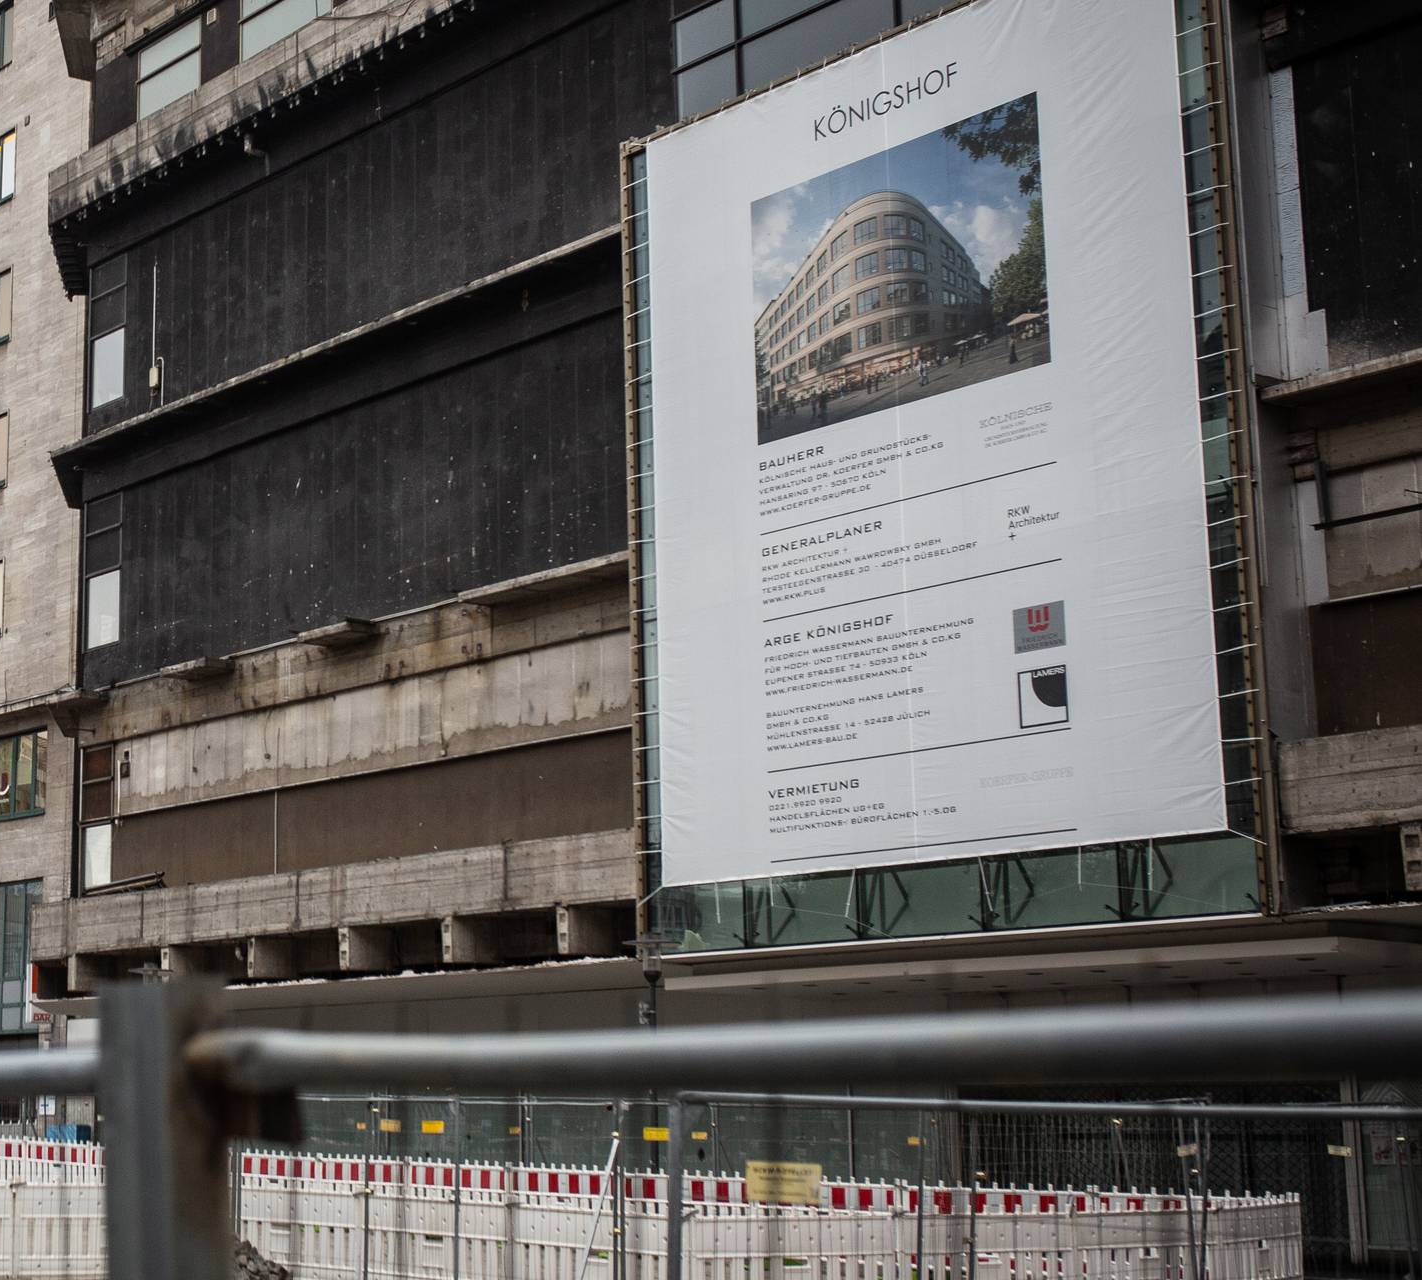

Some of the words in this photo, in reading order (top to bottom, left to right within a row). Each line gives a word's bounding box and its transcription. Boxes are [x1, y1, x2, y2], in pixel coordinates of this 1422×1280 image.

[814, 62, 957, 141] KÖNIGSHOF
[759, 446, 824, 471] BAUHERR
[759, 467, 806, 484] KÖLNISCHE
[839, 454, 858, 463] UND
[860, 434, 932, 457] GRUNDSTÜCKS-
[759, 476, 813, 495] VERWALTUNG
[833, 461, 873, 475] KOERFER
[876, 454, 902, 465] GMBH
[760, 488, 808, 506] HANSARING
[812, 484, 823, 493] 97
[862, 468, 886, 479] KÖLN
[760, 484, 872, 517] WWW.KOERFER-GRUPPE.DE
[1008, 505, 1030, 518] RKW
[1009, 512, 1060, 529] Architektur
[762, 521, 882, 557] GENERALPLANER
[762, 563, 779, 572] RKW
[782, 549, 839, 567] ARCHITEKTUR
[762, 572, 790, 583] RHODE
[794, 558, 851, 575] KELLERMANN
[854, 545, 911, 562] WAWROWSKY
[914, 539, 941, 549] GMBH
[762, 569, 855, 594] TERSTEEGENSTRASSE
[914, 541, 977, 562] DÜSSELDORF
[763, 587, 826, 606] WWW.RKW.PLUS
[764, 633, 801, 648] ARGE
[807, 614, 893, 640] KÖNIGSHOF
[764, 650, 809, 663] FRIEDRICH
[812, 637, 873, 654] WASSERMANN
[877, 618, 974, 642] BAUUNTERNEHMUNG
[764, 665, 781, 675] FÜR
[784, 661, 811, 670] HOCH-
[814, 657, 832, 666] UND
[835, 646, 888, 661] TIEFBAUTEN
[892, 641, 918, 650] GMBH
[931, 632, 961, 643] CO.KG
[765, 674, 804, 686] EUPENER
[807, 666, 846, 678] STRASSE
[902, 650, 927, 661] KÖLN
[766, 666, 913, 696] WWW.FRIEDRICH-WASSERMANN.DE
[1033, 667, 1065, 678] LAMERS
[766, 698, 855, 719] BAUUNTERNEHMUNG
[859, 694, 883, 703] HANS
[887, 687, 924, 698] LAMERS
[766, 721, 791, 730] GMBH
[803, 714, 829, 724] CO.KG
[767, 723, 841, 741] MÜHLENSTRASSE
[897, 710, 930, 721] JÜLICH
[767, 733, 858, 752] WWW.LAMERS-BAU.DE
[769, 779, 859, 799] VERMIETUNG
[770, 806, 850, 823] HANDELSFLÄCHEN
[853, 803, 885, 813] UG+EG
[851, 809, 918, 825] BÜROFLÄCHEN
